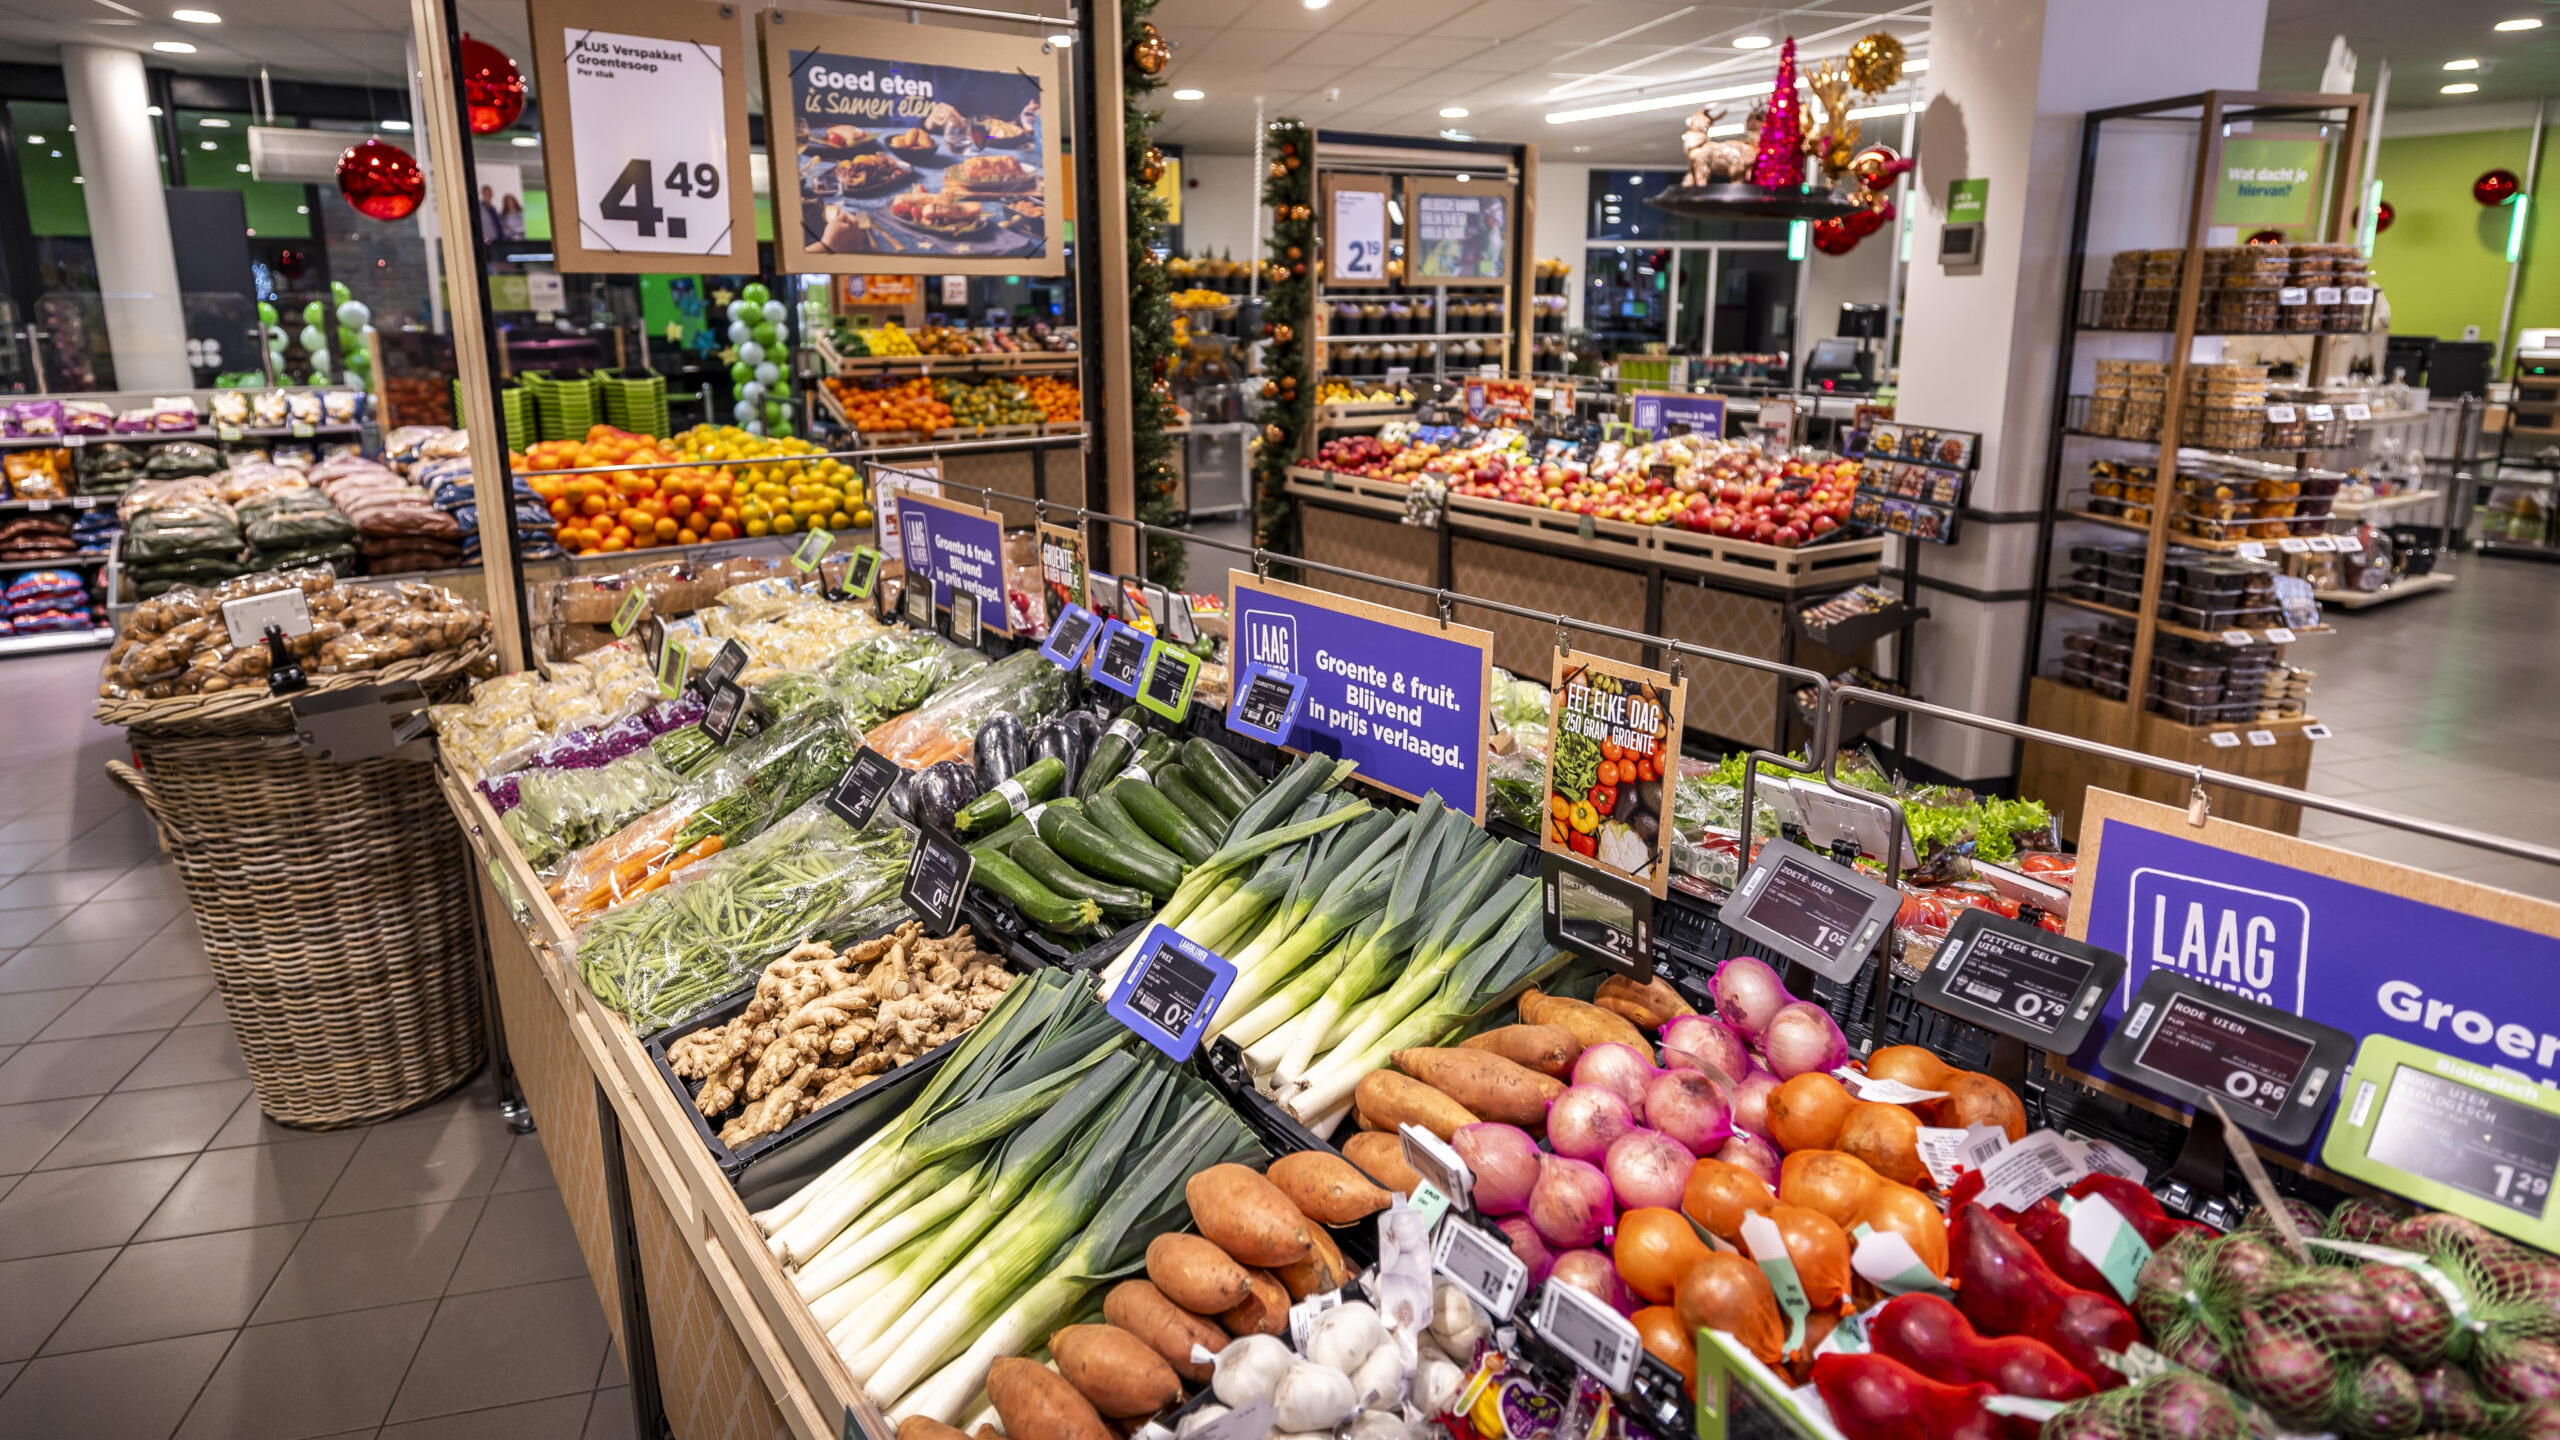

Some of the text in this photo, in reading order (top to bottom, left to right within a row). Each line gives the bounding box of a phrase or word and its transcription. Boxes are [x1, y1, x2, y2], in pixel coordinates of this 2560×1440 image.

[576, 40, 682, 62] PLUS Verspakket
[576, 54, 658, 73] Groentesoep
[577, 67, 615, 79] Per stuk
[808, 65, 933, 98] Goed eten
[805, 88, 821, 113] is
[825, 92, 893, 119] Samen
[2228, 167, 2308, 184] Wat dacht je
[2237, 184, 2292, 197] hiervan?
[600, 157, 720, 239] 4.49
[1348, 240, 1381, 272] 2.19
[907, 521, 926, 548] LAAG
[934, 533, 996, 566] Groente & fruit.
[949, 554, 982, 579] Blijvend
[1043, 543, 1073, 573] GROENTE
[936, 566, 1002, 603] in prijs verlaagd.
[1252, 621, 1290, 666] LAAG
[1315, 649, 1461, 712] Groente & fruit.
[1346, 684, 1422, 728] Blijvend
[1567, 682, 1660, 735] EET ELKE DAG
[1309, 697, 1465, 770] in prijs verlaagd.
[1564, 712, 1655, 756] 250 GRAM GROENTE
[1562, 877, 1627, 909] ZOETE AARDAPPEL
[1780, 865, 1809, 883] ZOETE
[1811, 880, 1834, 895] UIEN
[1606, 929, 1633, 954] 2.79
[1813, 925, 1847, 952] 1.05
[1973, 949, 1987, 958] PLUS
[1978, 941, 2004, 955] UIEN
[1982, 933, 2060, 965] PITTIGE GELE
[2152, 893, 2276, 989] LAAG
[1159, 950, 1174, 963] PREI
[1164, 1003, 1193, 1031] 0.72
[2015, 993, 2066, 1023] 0.79
[2167, 1016, 2185, 1027] PLUS
[2175, 1002, 2246, 1035] RODE UIEN
[2225, 1070, 2287, 1108] 0.86
[2436, 1057, 2539, 1102] Biologisch
[2449, 1088, 2490, 1109] UIEN
[2494, 1164, 2548, 1205] 1.29
